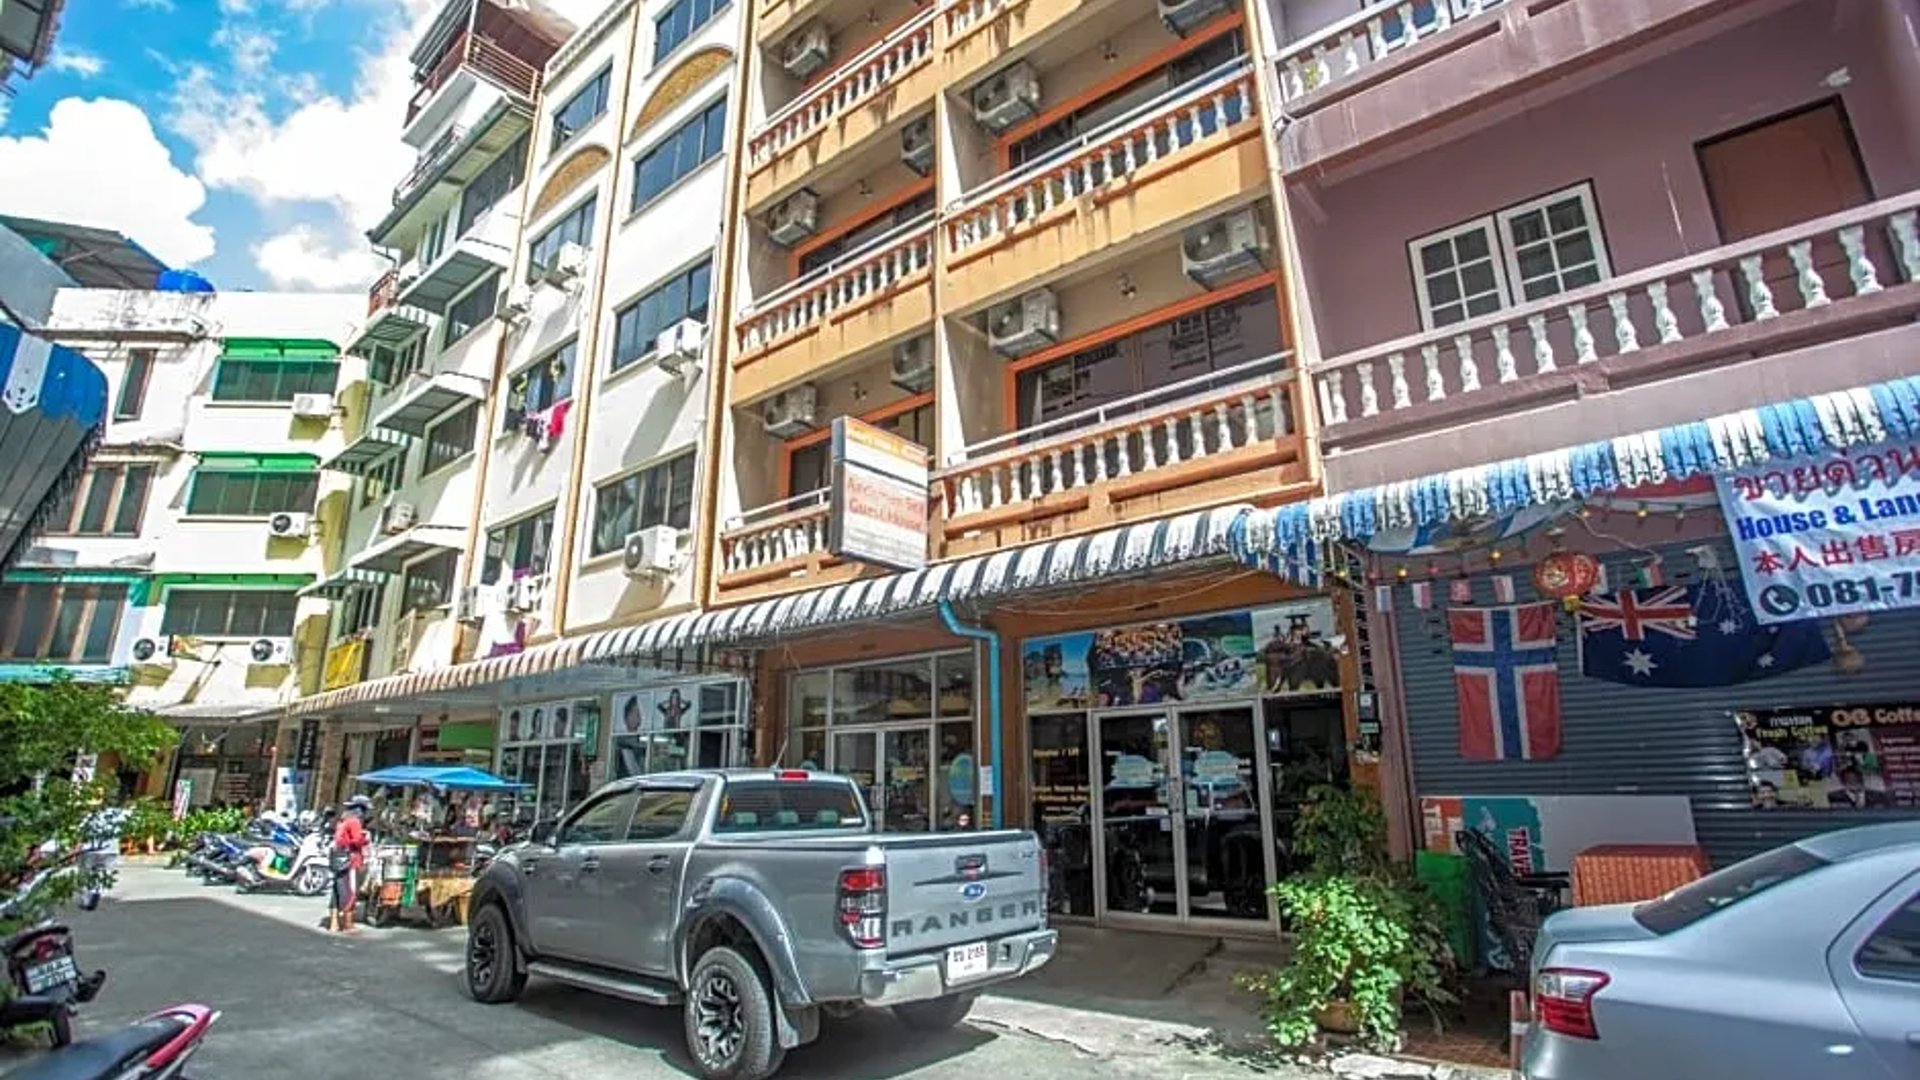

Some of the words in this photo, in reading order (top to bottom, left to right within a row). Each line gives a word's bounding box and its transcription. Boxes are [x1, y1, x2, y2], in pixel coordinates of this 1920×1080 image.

[1737, 508, 1827, 541] House
[1834, 505, 1857, 525] &
[1807, 571, 1920, 608] 081-7
[1509, 828, 1530, 877] TRAVE
[892, 901, 1037, 937] RANGER
